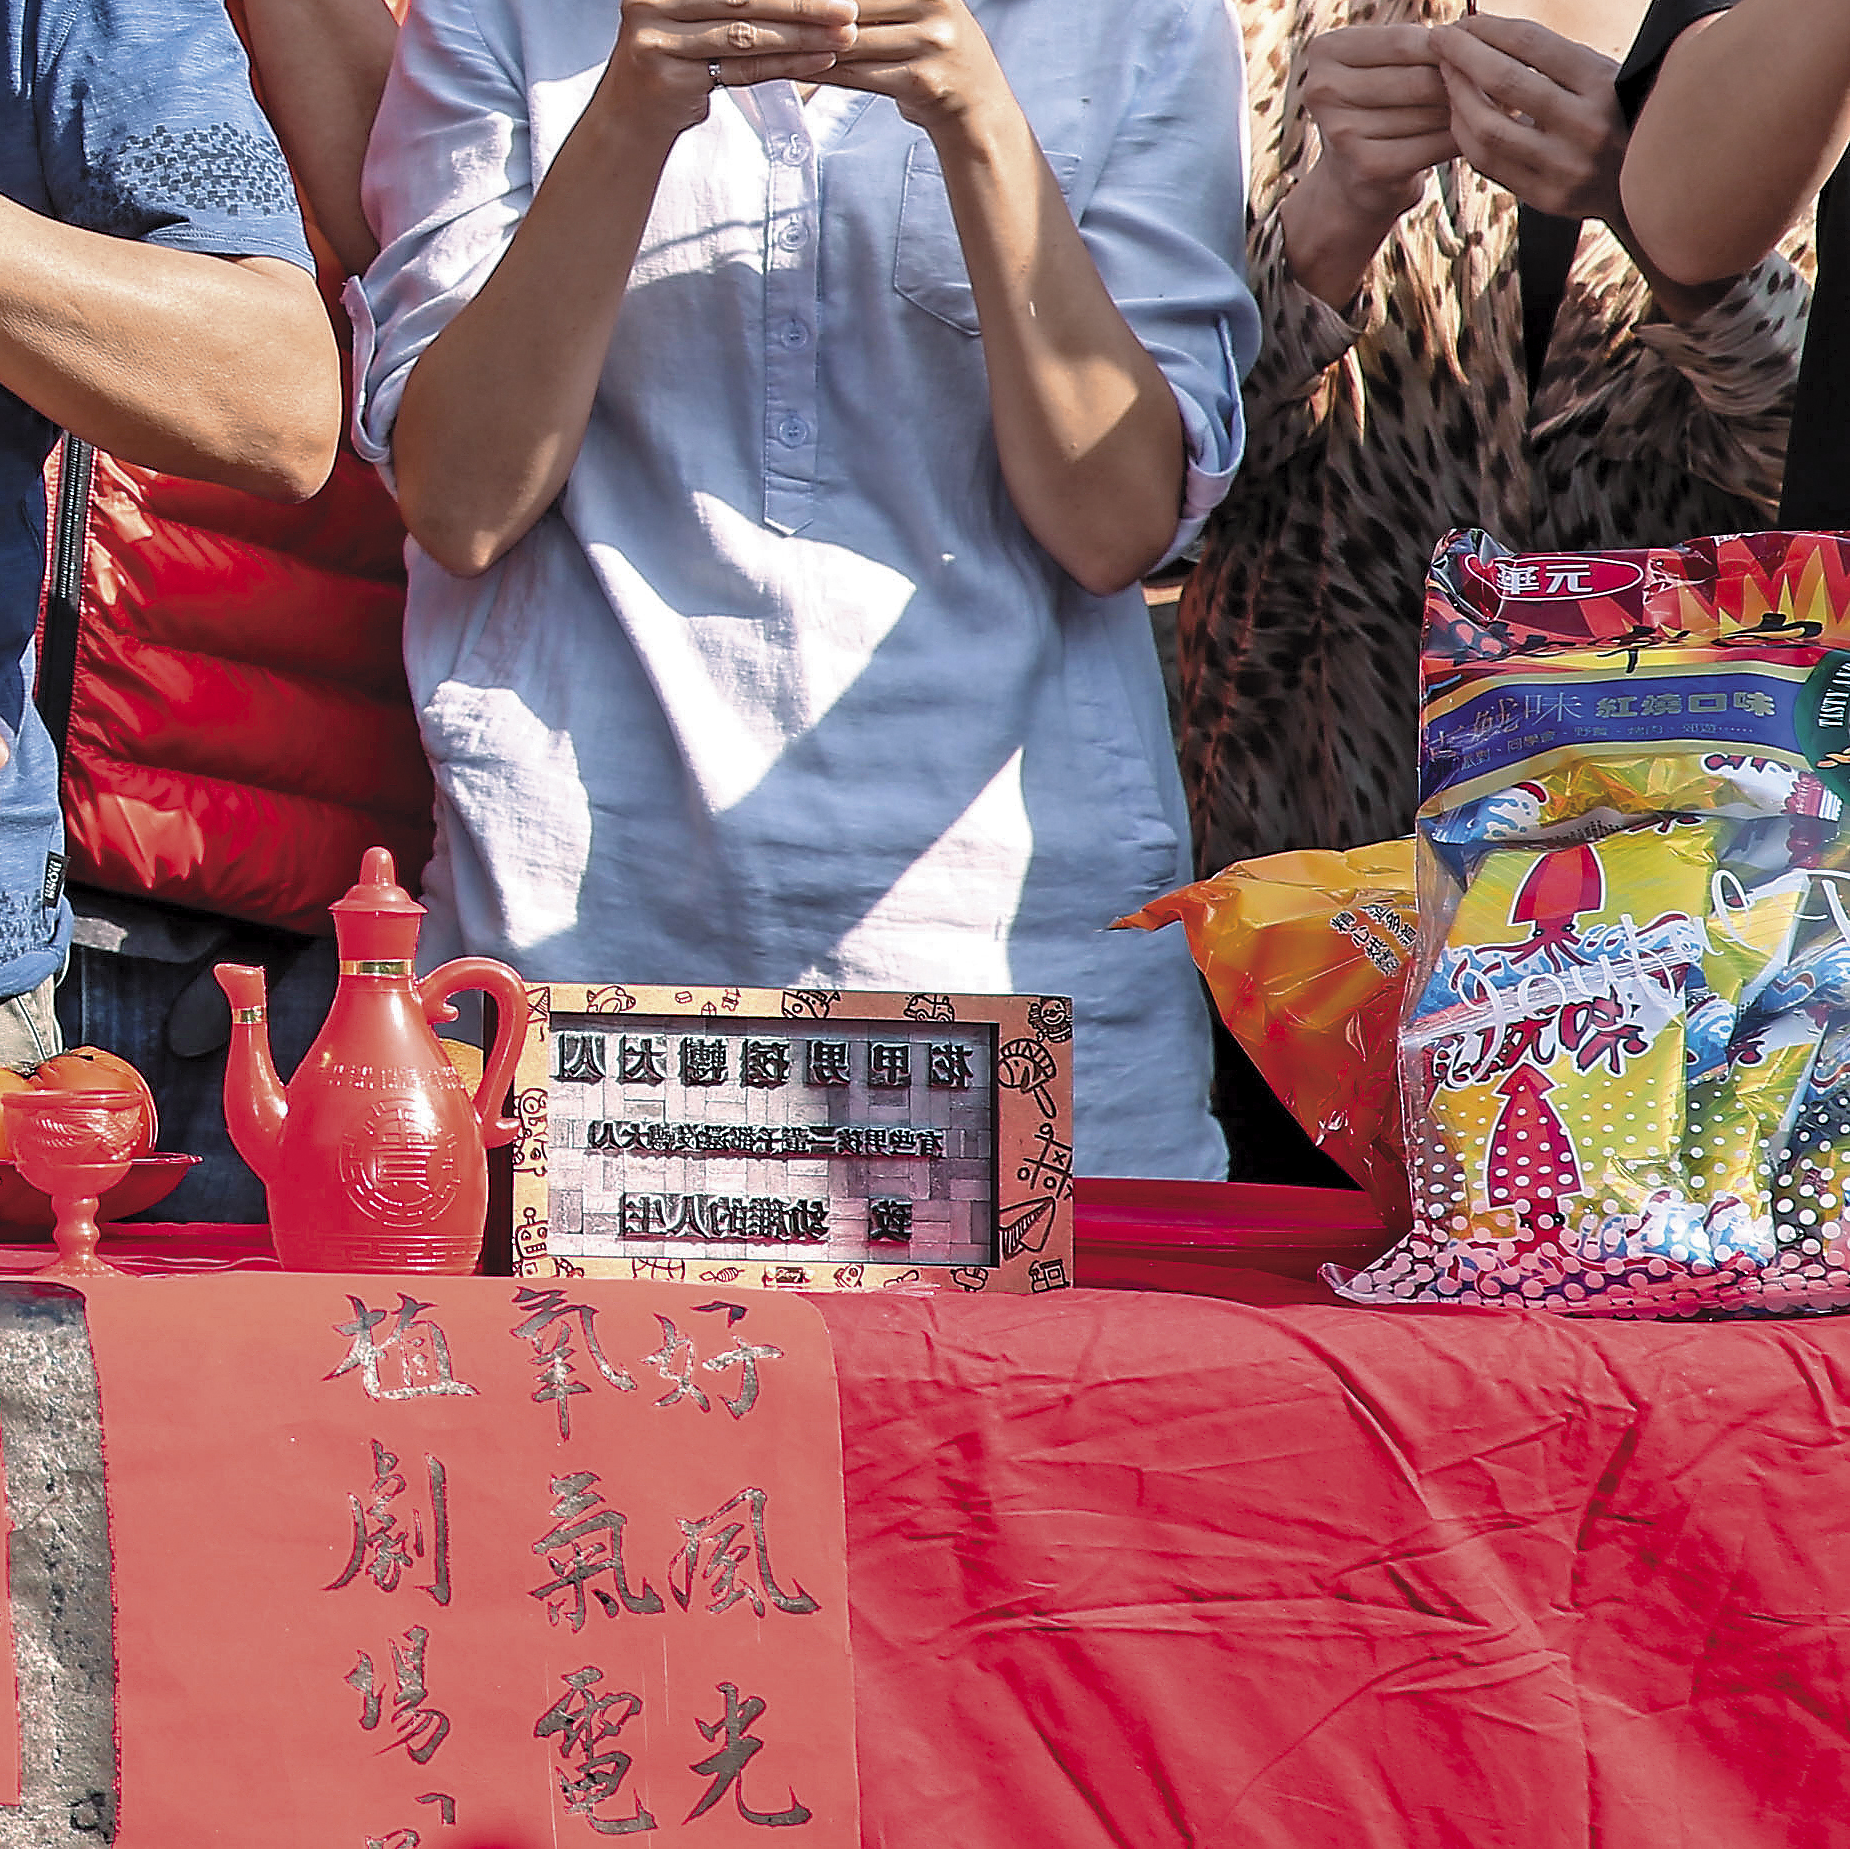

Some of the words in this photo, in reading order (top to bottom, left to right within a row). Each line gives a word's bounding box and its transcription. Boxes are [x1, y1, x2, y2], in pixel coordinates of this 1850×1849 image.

[1495, 561, 1596, 596] 華元
[1595, 692, 1776, 718] 紅燒口味
[1819, 688, 1849, 728] TASTY
[323, 1292, 479, 1849] 植劇場
[641, 1300, 823, 1828] 好風光
